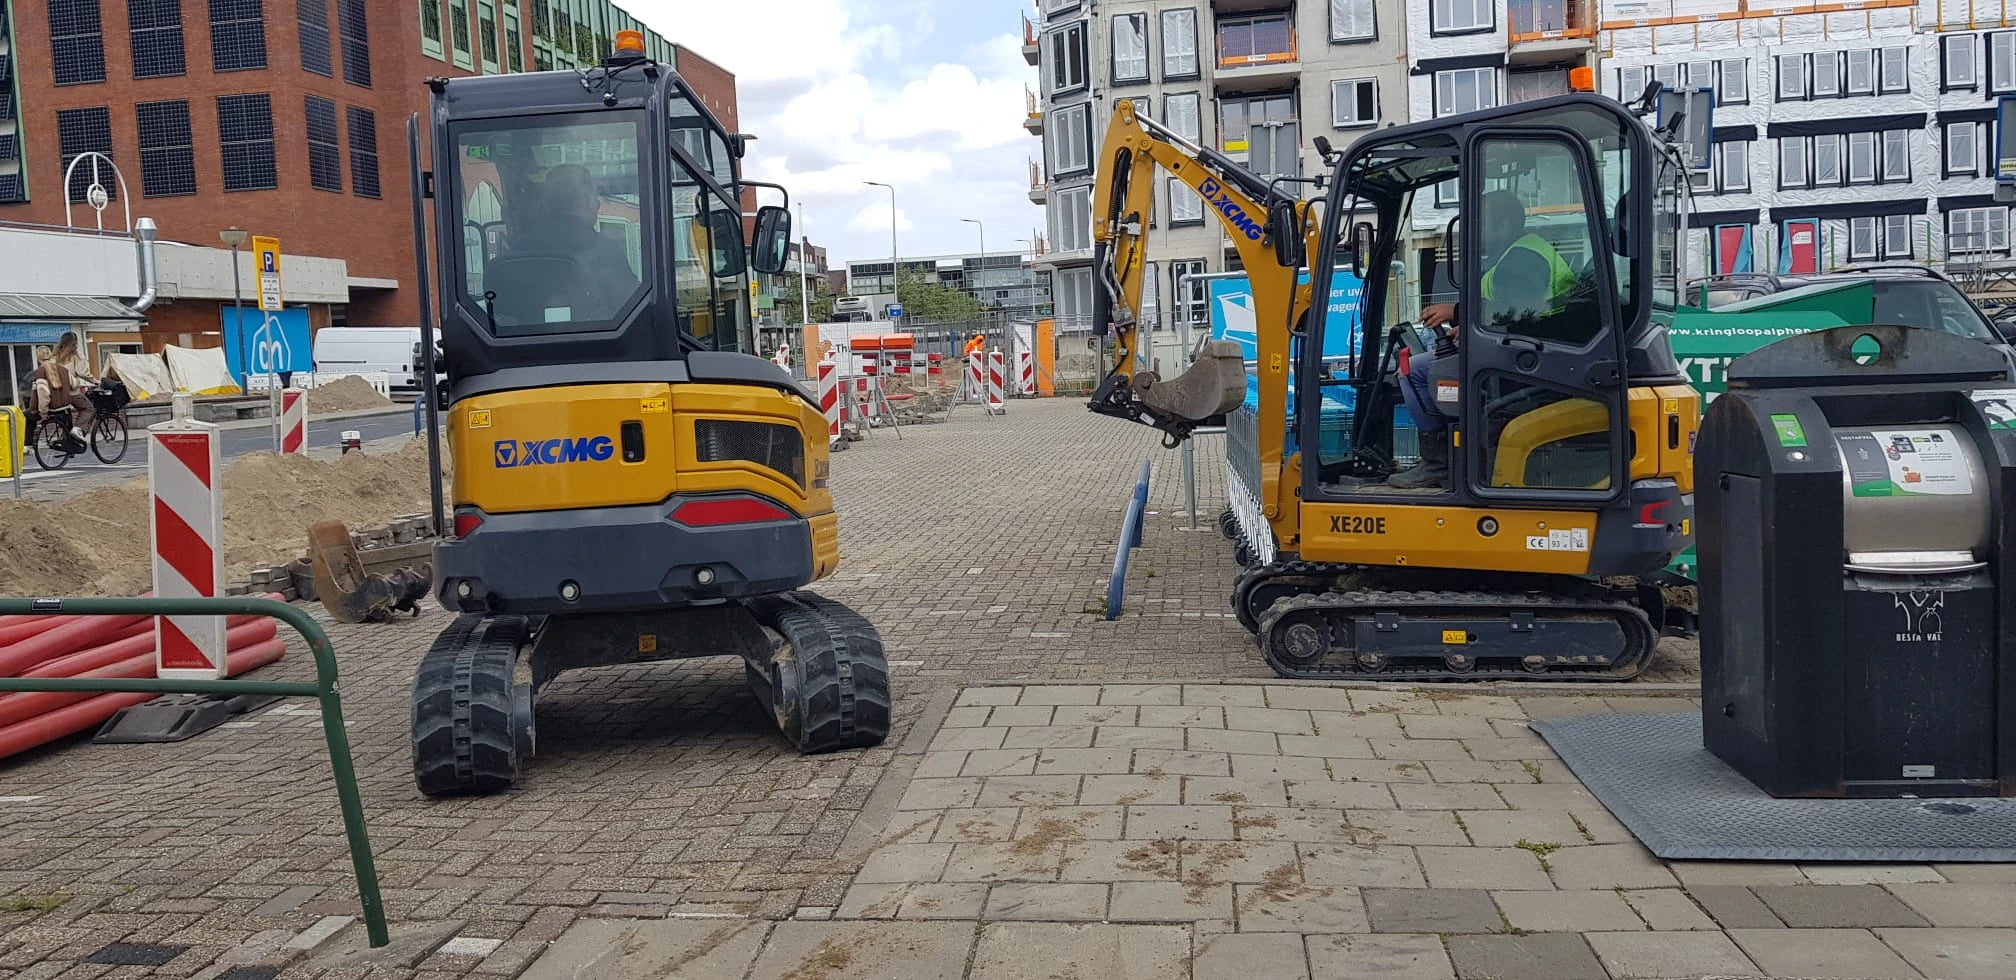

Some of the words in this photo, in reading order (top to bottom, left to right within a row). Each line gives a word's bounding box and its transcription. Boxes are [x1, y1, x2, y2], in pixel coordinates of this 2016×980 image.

[1209, 192, 1263, 241] XCMG
[264, 252, 273, 271] P
[1329, 287, 1345, 297] ier
[519, 435, 614, 467] XCMG
[1329, 515, 1386, 534] XE20E
